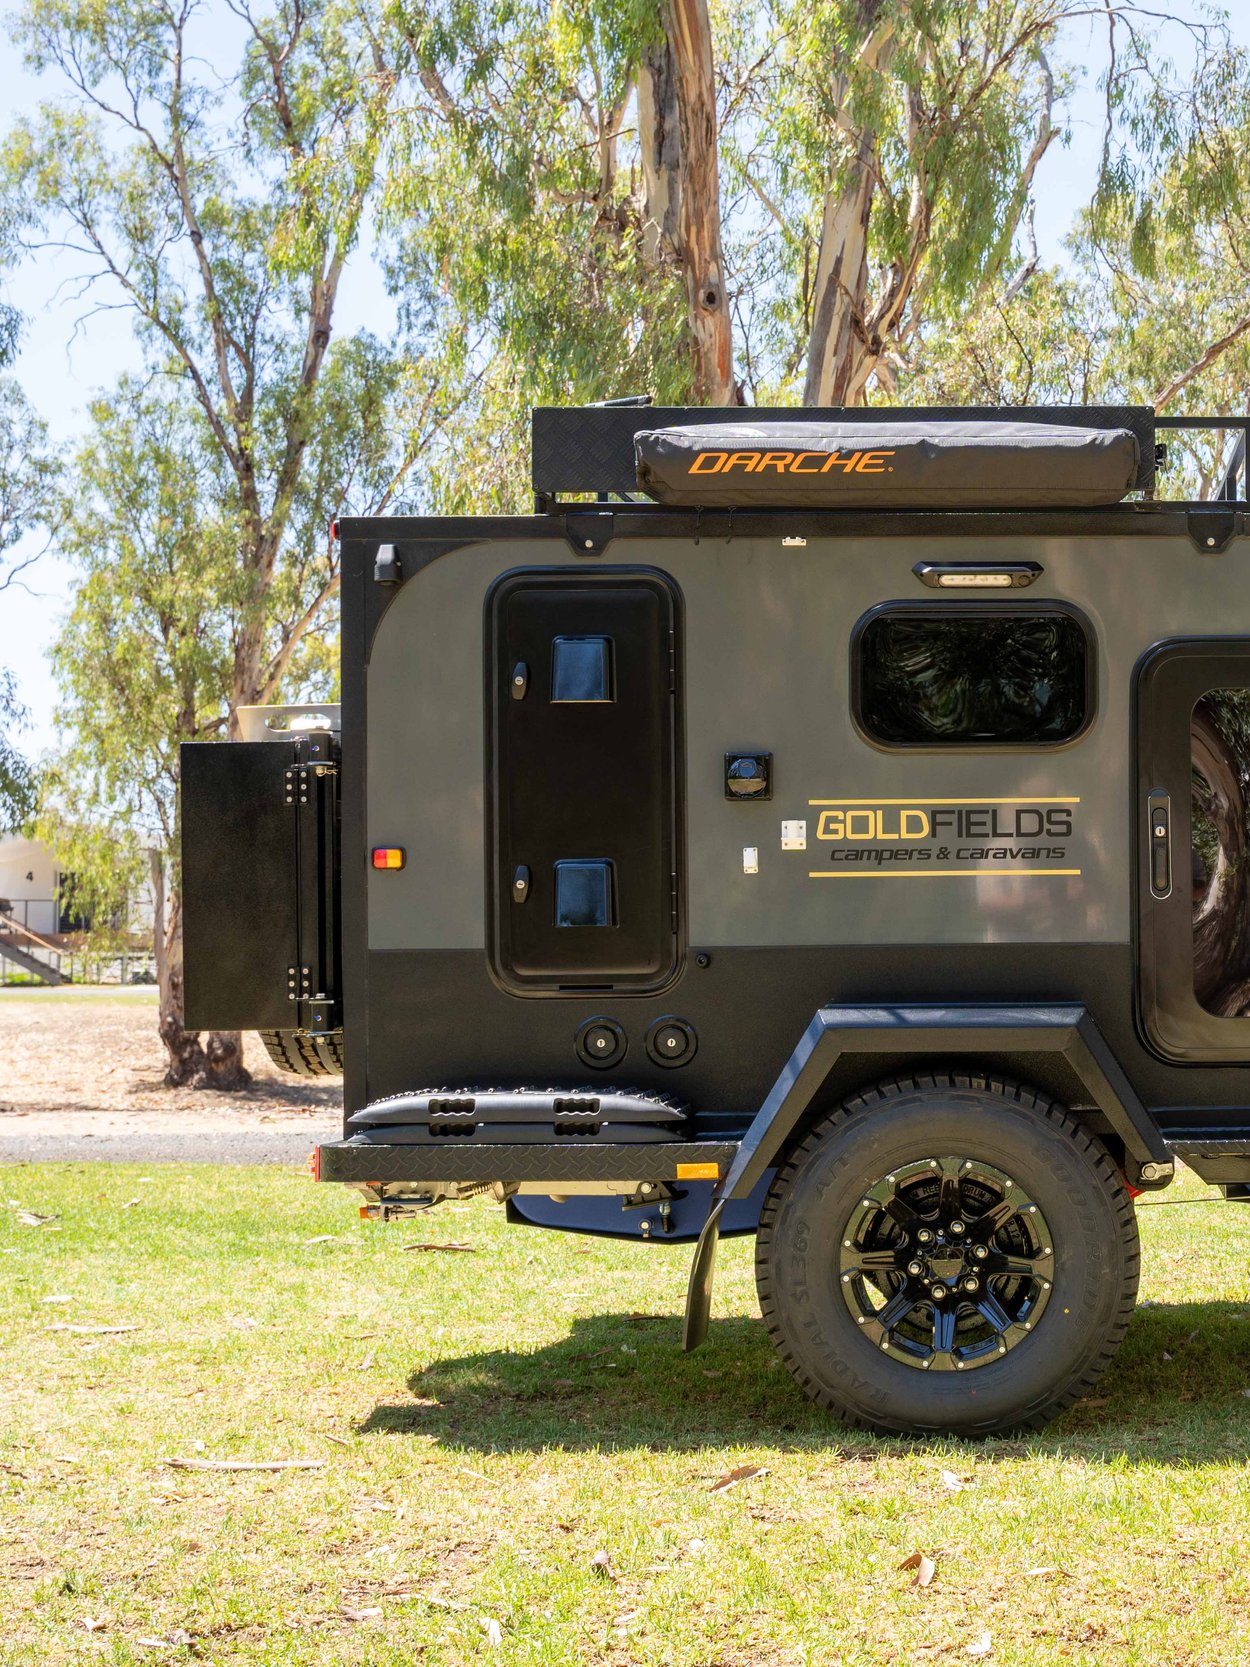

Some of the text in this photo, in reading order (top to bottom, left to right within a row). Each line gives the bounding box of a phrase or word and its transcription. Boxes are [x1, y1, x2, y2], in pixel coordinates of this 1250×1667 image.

[687, 450, 896, 474] DARCHE
[816, 808, 1072, 841] GOLDFIELDS
[830, 845, 1066, 866] campers & caravans
[800, 1317, 891, 1405] RADIAL
